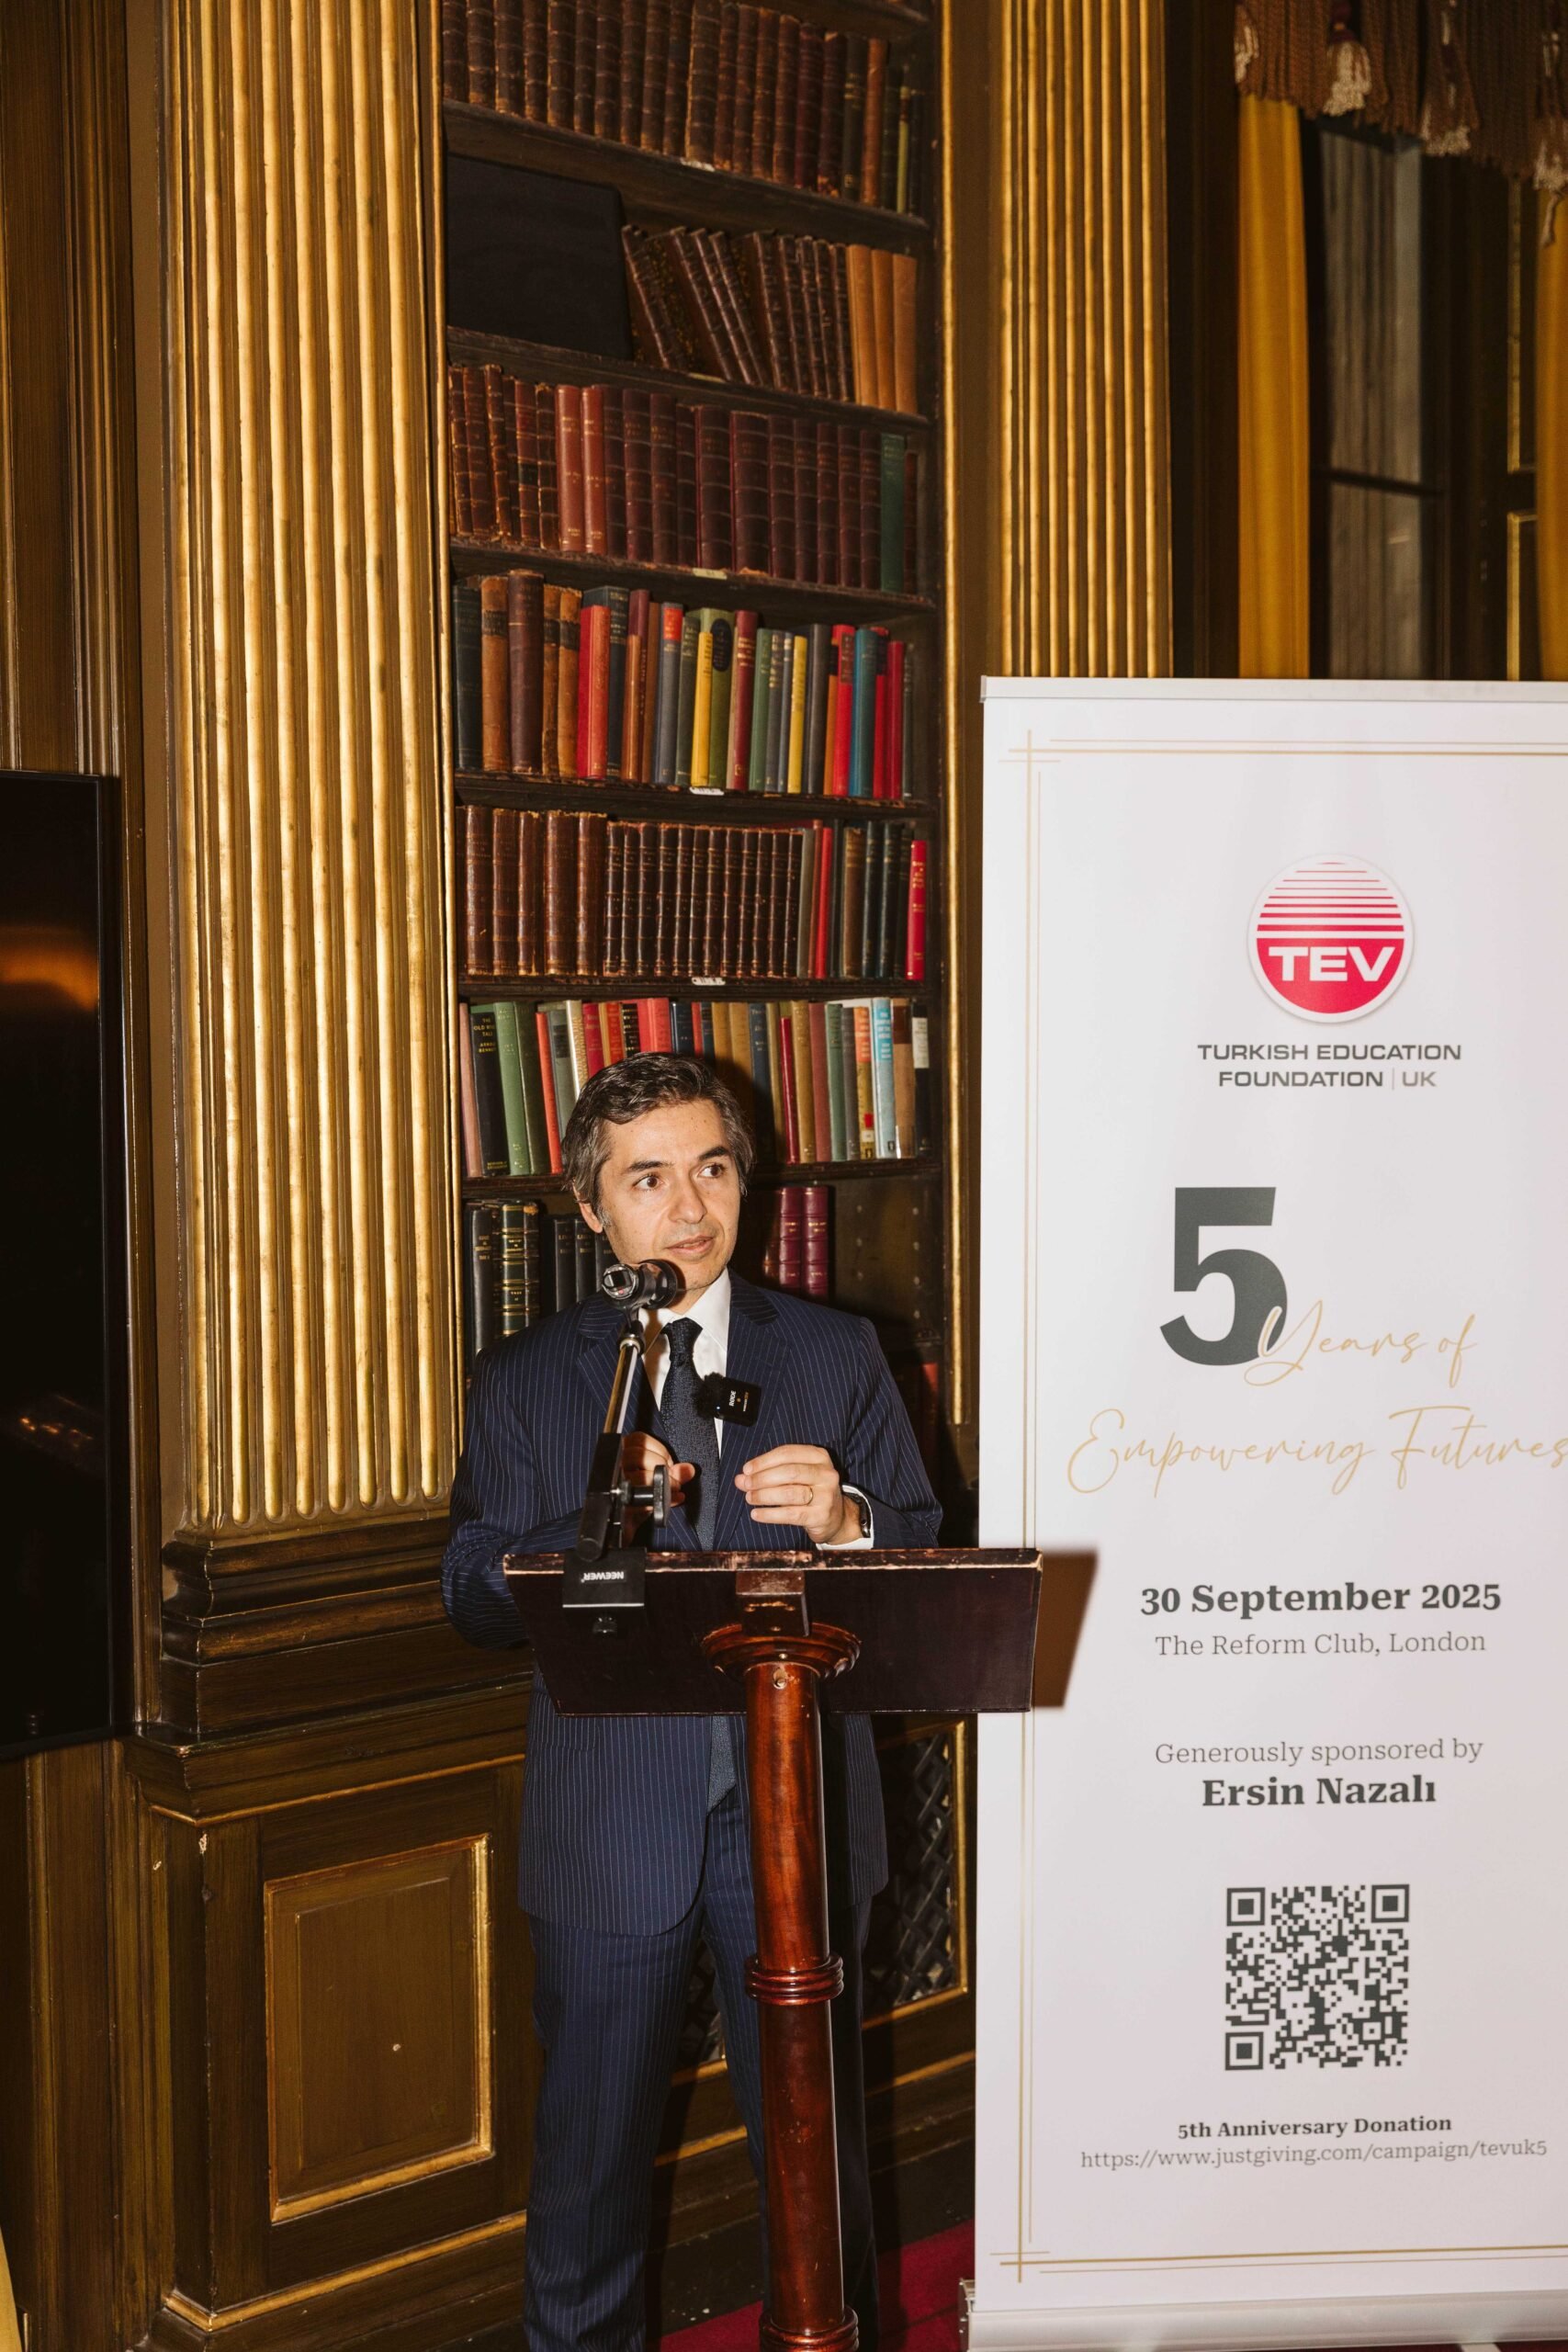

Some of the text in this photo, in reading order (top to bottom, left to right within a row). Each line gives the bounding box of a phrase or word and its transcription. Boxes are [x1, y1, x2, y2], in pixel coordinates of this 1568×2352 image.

[1269, 946, 1396, 981] TEV
[1197, 1045, 1461, 1060] TURKISH EDUCATION
[1219, 1071, 1437, 1087] FOUNDATION UK
[1160, 1187, 1478, 1388] 5 Years of
[1067, 1405, 1568, 1498] Empowering Futures
[583, 1571, 625, 1581] NEEWER
[1140, 1581, 1502, 1620] 30 September 2025
[1155, 1631, 1486, 1657] The Reform Club, London
[1155, 1737, 1483, 1768] Generously sponsored by
[1202, 1773, 1438, 1807] Ersin Nazalı
[1178, 2115, 1452, 2143] 5th Anniversary Donation
[1080, 2139, 1548, 2171] https://www.justgiving.com/campaign/tevuk5
